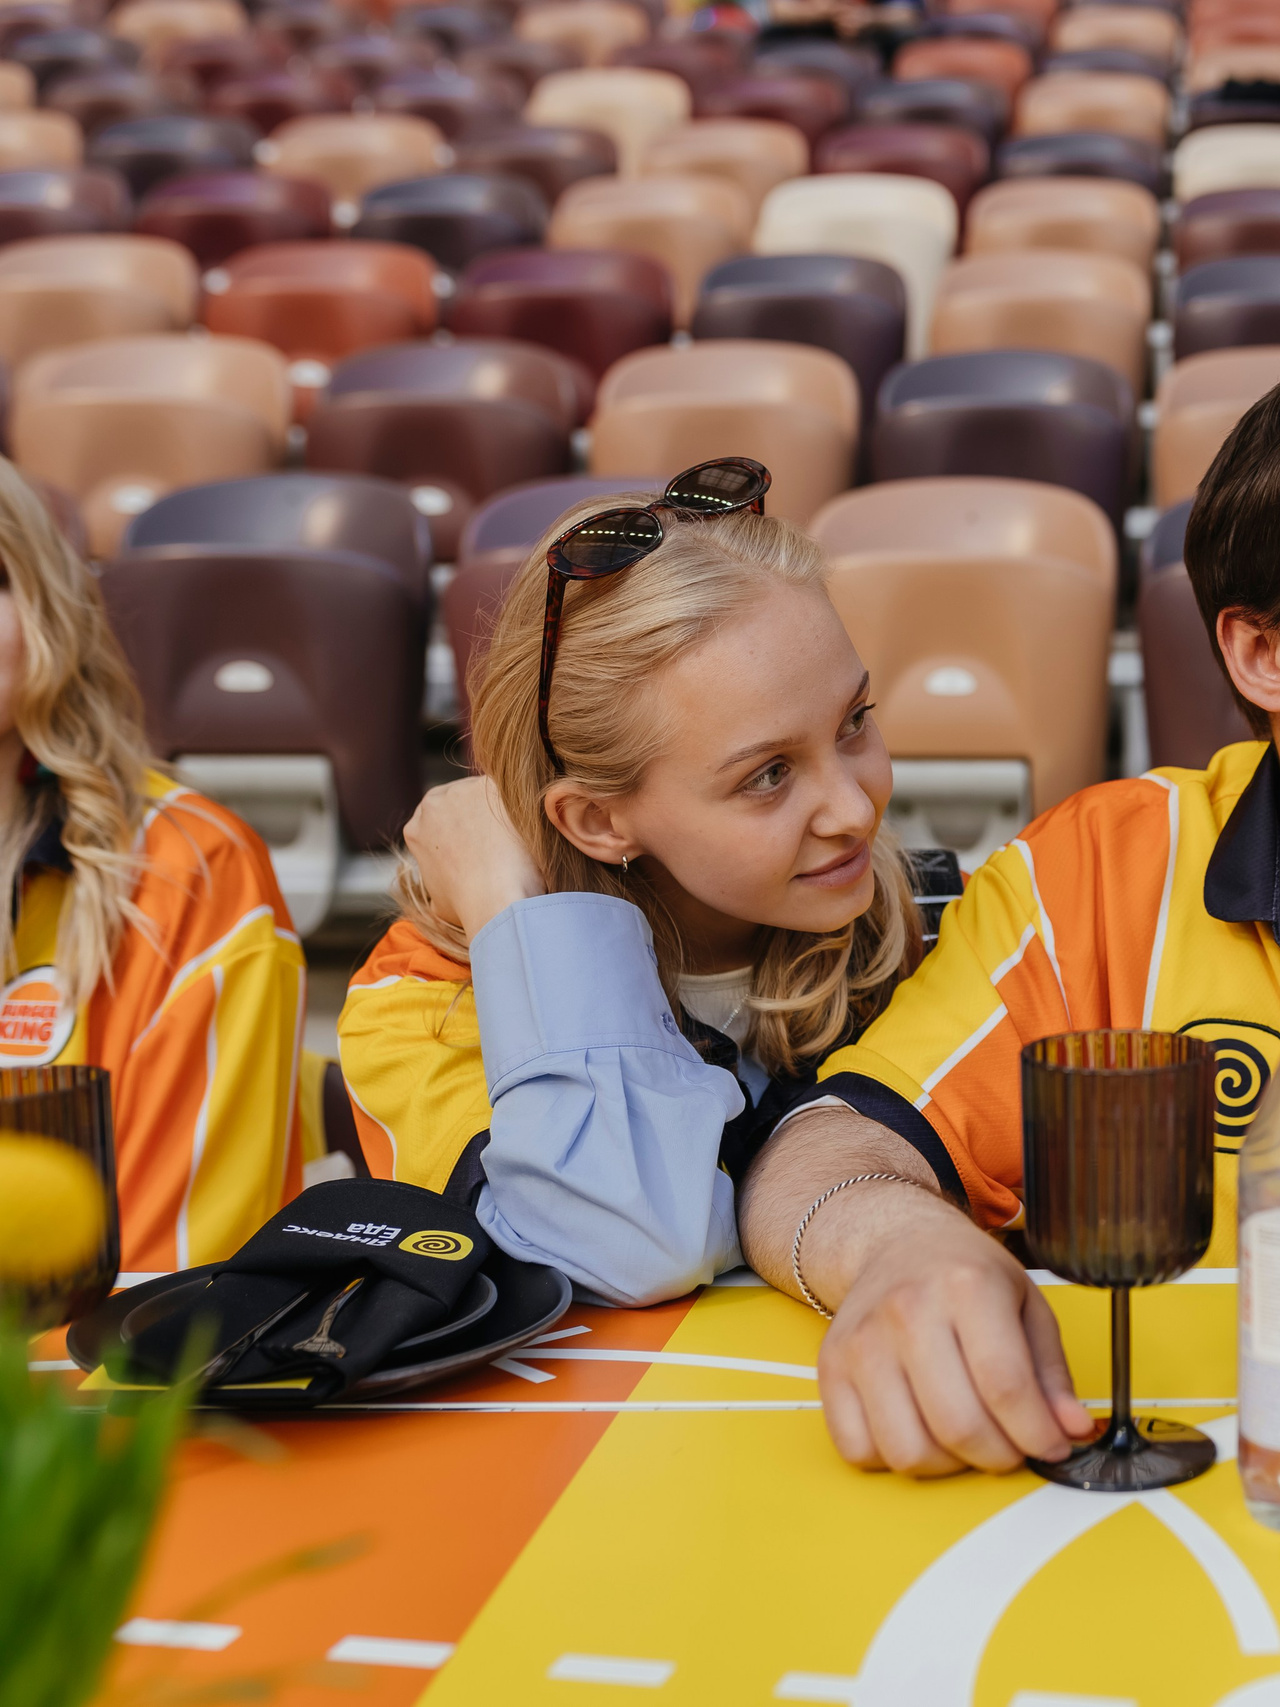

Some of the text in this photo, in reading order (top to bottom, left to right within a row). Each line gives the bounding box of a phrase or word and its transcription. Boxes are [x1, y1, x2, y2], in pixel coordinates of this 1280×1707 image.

[0, 1020, 53, 1042] KING
[282, 1224, 392, 1247] Яндекс
[346, 1222, 402, 1240] Еда
